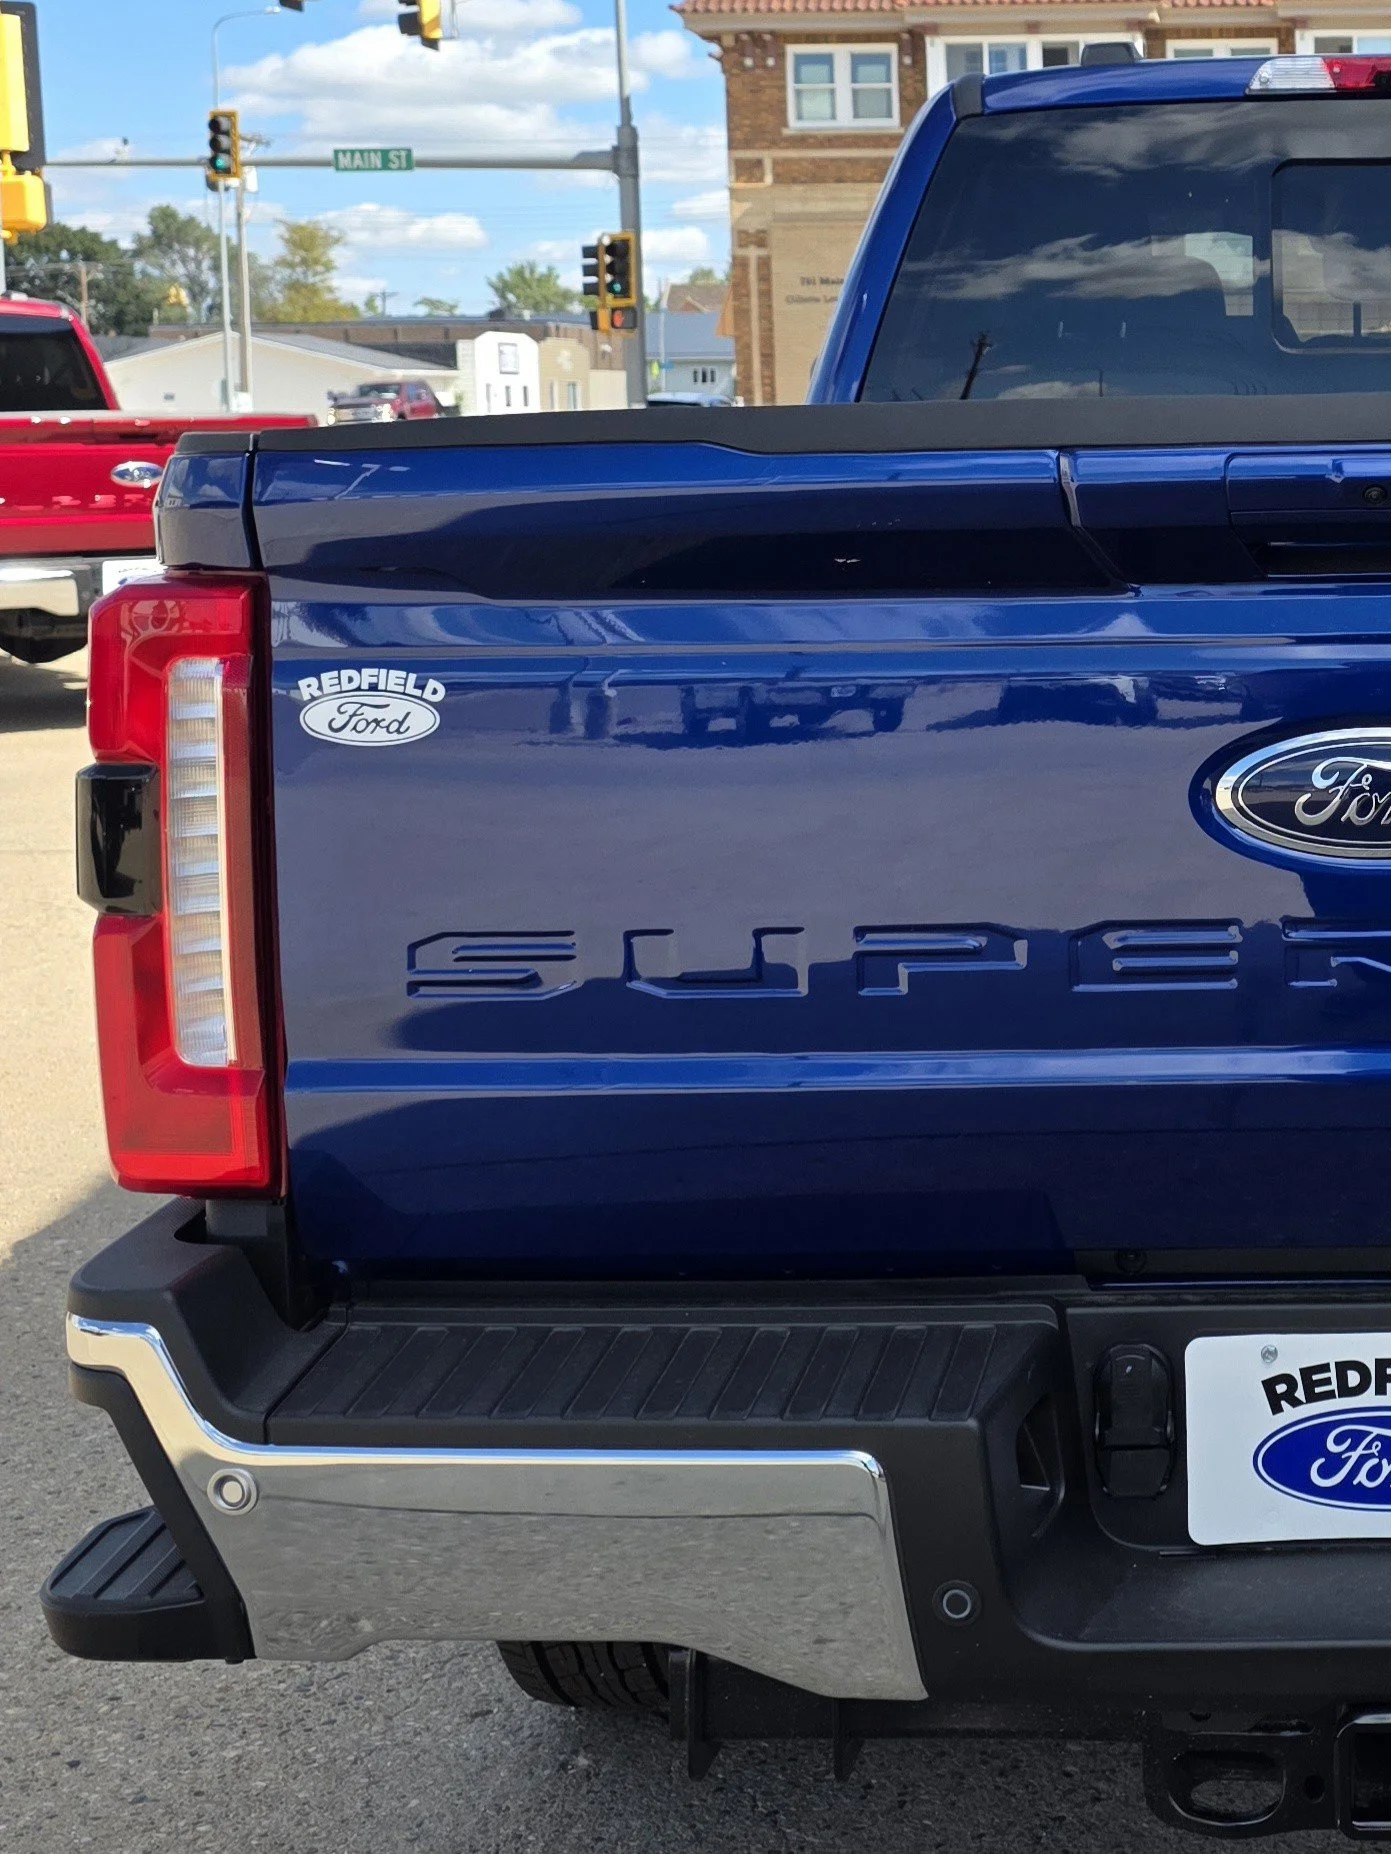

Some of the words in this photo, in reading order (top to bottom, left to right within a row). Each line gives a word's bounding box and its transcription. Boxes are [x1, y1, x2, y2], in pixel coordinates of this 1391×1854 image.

[338, 150, 382, 169] MAIN
[388, 150, 407, 169] ST
[298, 668, 446, 702] REDFIELD
[327, 701, 412, 735] Ford
